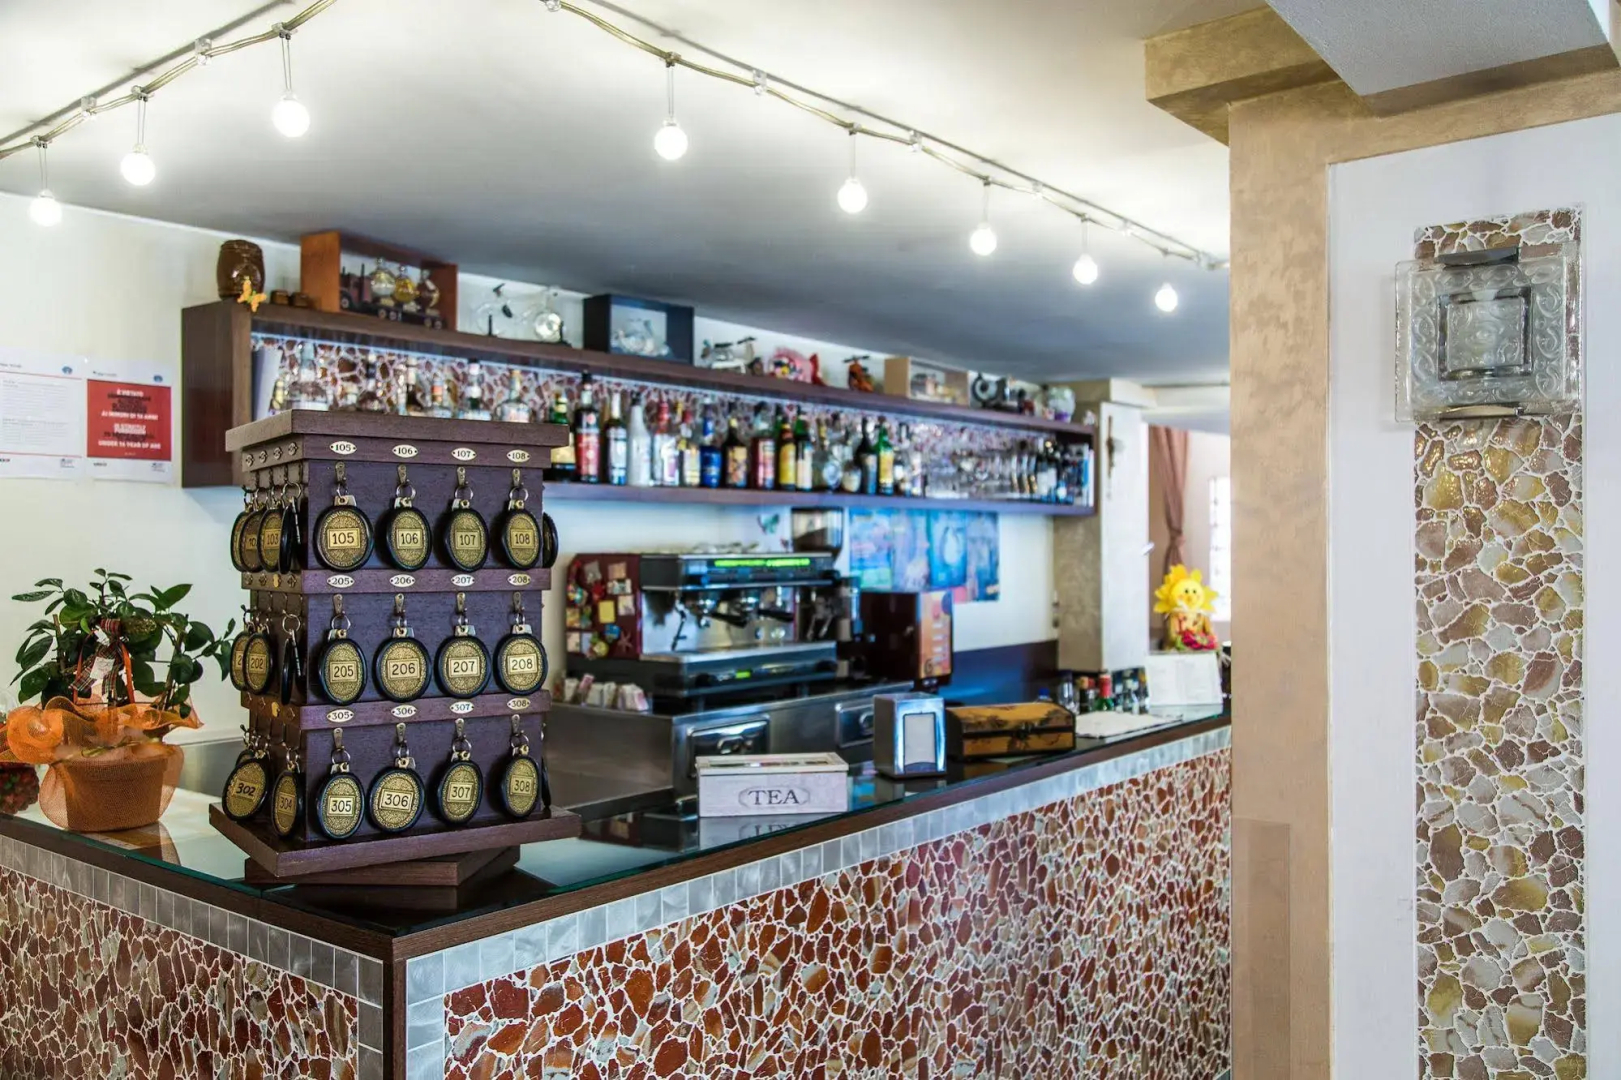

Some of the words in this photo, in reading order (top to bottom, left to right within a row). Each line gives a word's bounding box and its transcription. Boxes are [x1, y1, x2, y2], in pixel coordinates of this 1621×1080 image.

[334, 444, 351, 452] 105
[248, 537, 257, 546] 10
[266, 534, 279, 545] 103
[332, 532, 356, 544] 105
[401, 532, 419, 544] 106
[460, 534, 476, 546] 107
[514, 533, 530, 544] 108
[332, 578, 350, 586] 205
[394, 577, 411, 585] 206
[455, 576, 472, 584] 207
[512, 576, 528, 584] 208
[250, 658, 264, 669] 202
[392, 662, 416, 675] 206
[453, 661, 475, 674] 207
[512, 658, 532, 670] 208
[334, 665, 354, 678] 205
[396, 707, 412, 715] 306
[454, 703, 470, 711] 307
[332, 712, 350, 720] 305
[236, 782, 256, 796] 302
[452, 785, 470, 798] 307
[514, 780, 530, 792] 308
[280, 796, 292, 810] 304
[384, 794, 408, 807] 306
[748, 789, 800, 806] TEA
[331, 800, 352, 813] 305
